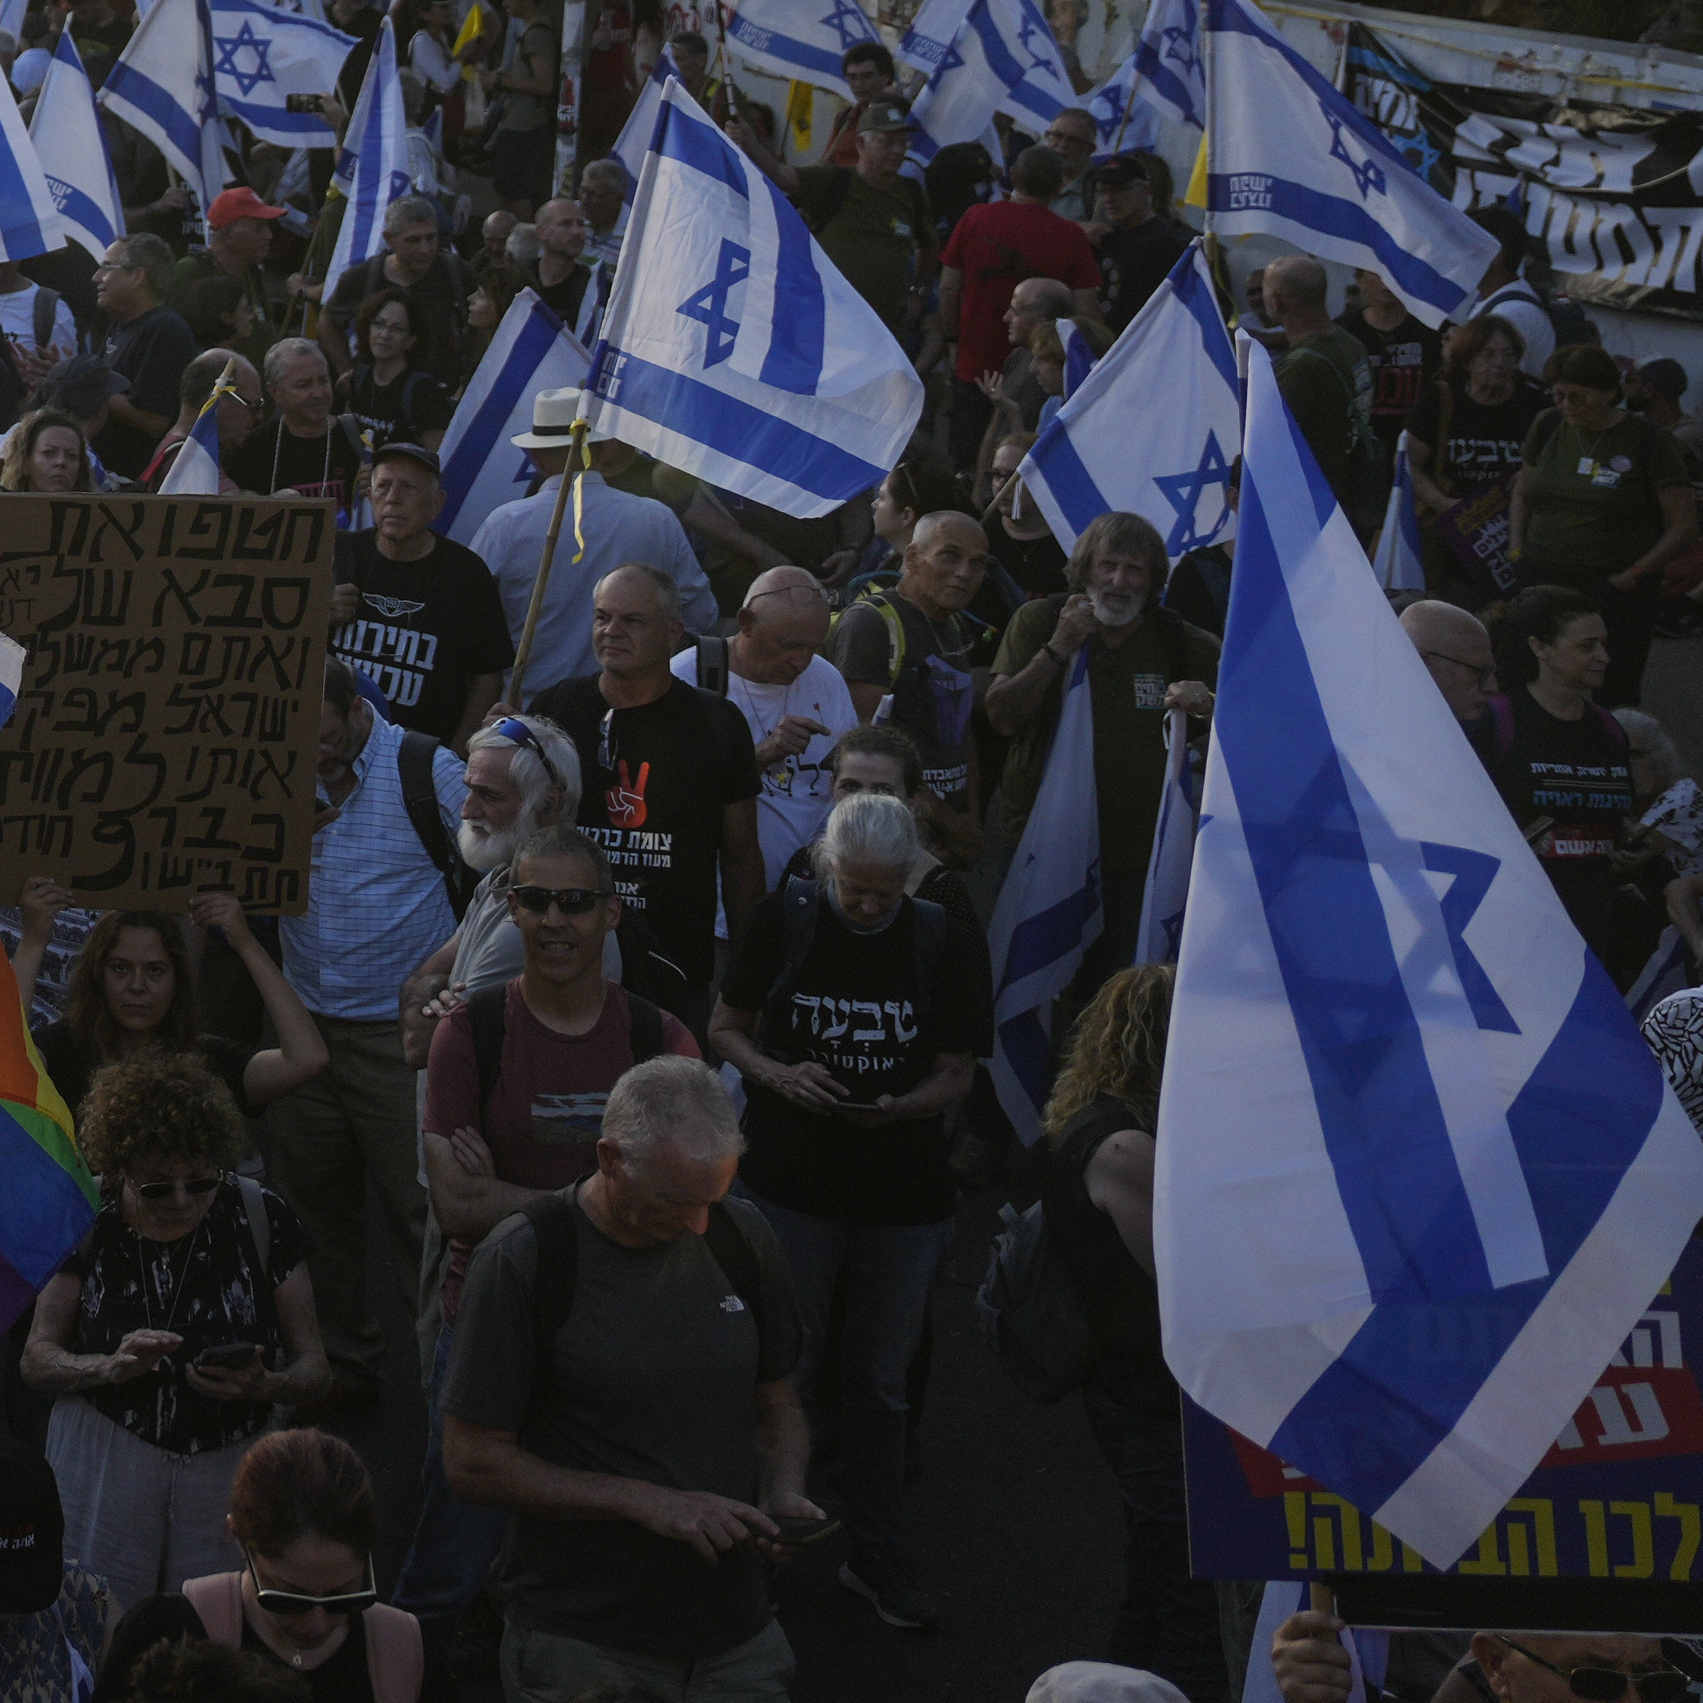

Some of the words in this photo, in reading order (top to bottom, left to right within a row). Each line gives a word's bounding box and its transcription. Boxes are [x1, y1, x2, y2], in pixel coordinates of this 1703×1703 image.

[154, 502, 326, 563] חטפו
[152, 567, 311, 630] סבא
[170, 636, 311, 692] ואתם
[5, 686, 146, 753] מפק
[164, 682, 299, 743] ישראל
[175, 745, 298, 802] אותי
[147, 805, 285, 863] כבר
[627, 829, 673, 852] צומת
[642, 850, 672, 868] מעוז
[1283, 1489, 1560, 1579] הבתה!
[1579, 1490, 1703, 1581] לכו
